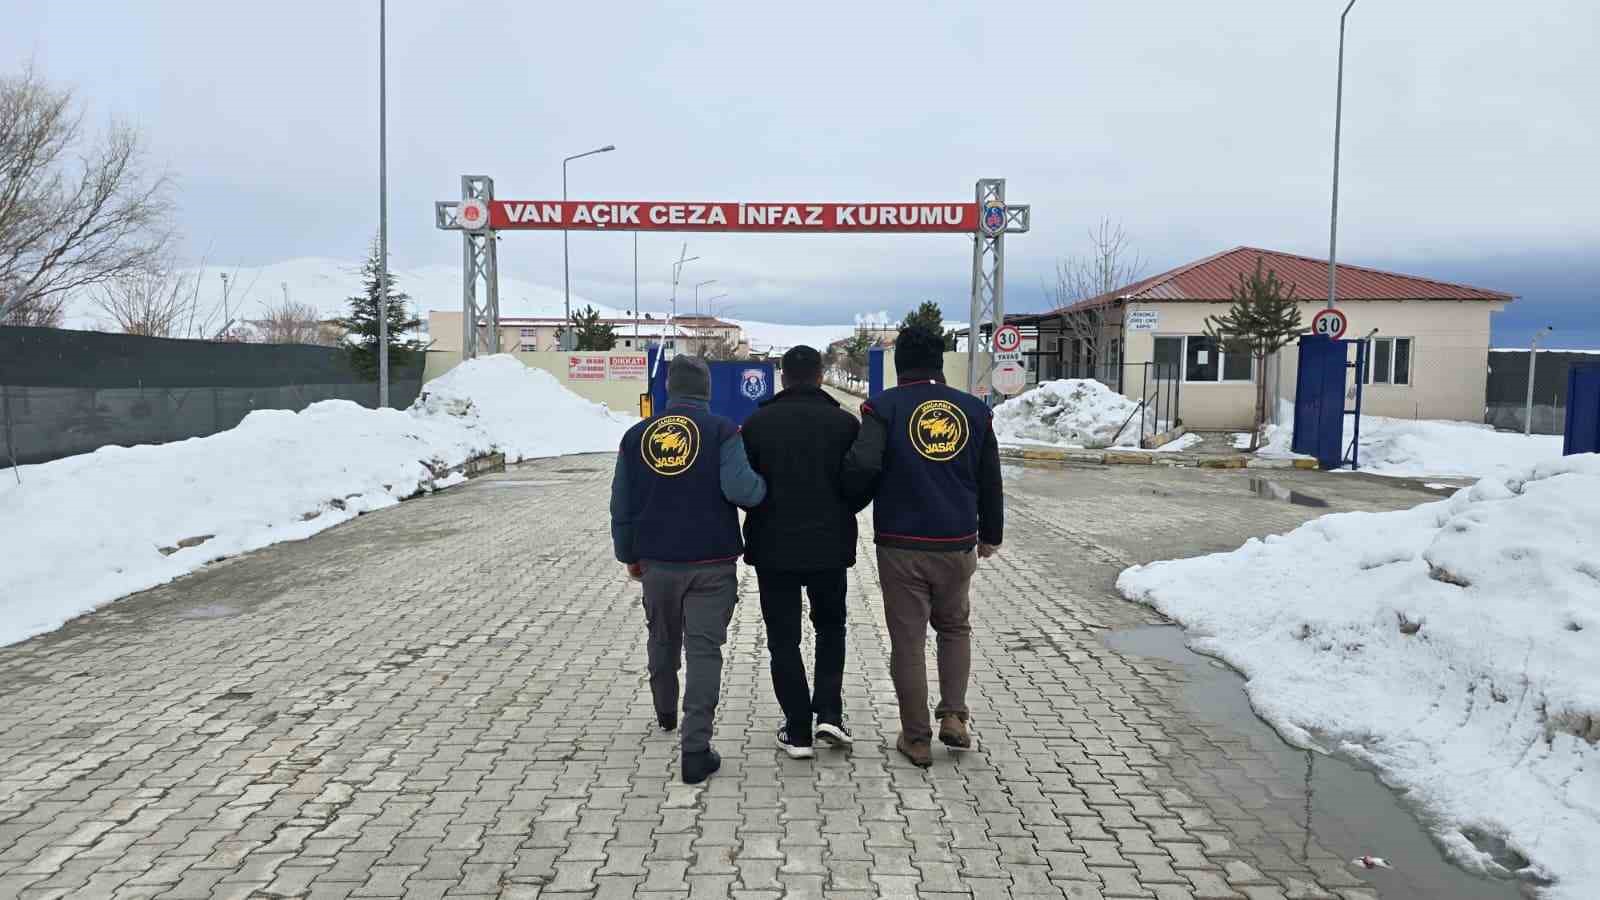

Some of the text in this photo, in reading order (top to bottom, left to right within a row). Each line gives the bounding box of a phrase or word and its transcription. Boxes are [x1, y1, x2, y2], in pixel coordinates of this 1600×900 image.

[503, 202, 964, 228] VAN AÇIK CEZA İNFAZ KURUMU
[1319, 317, 1340, 333] 30
[999, 333, 1016, 344] 30
[926, 441, 957, 453] JASAT
[655, 455, 687, 468] JASAT
